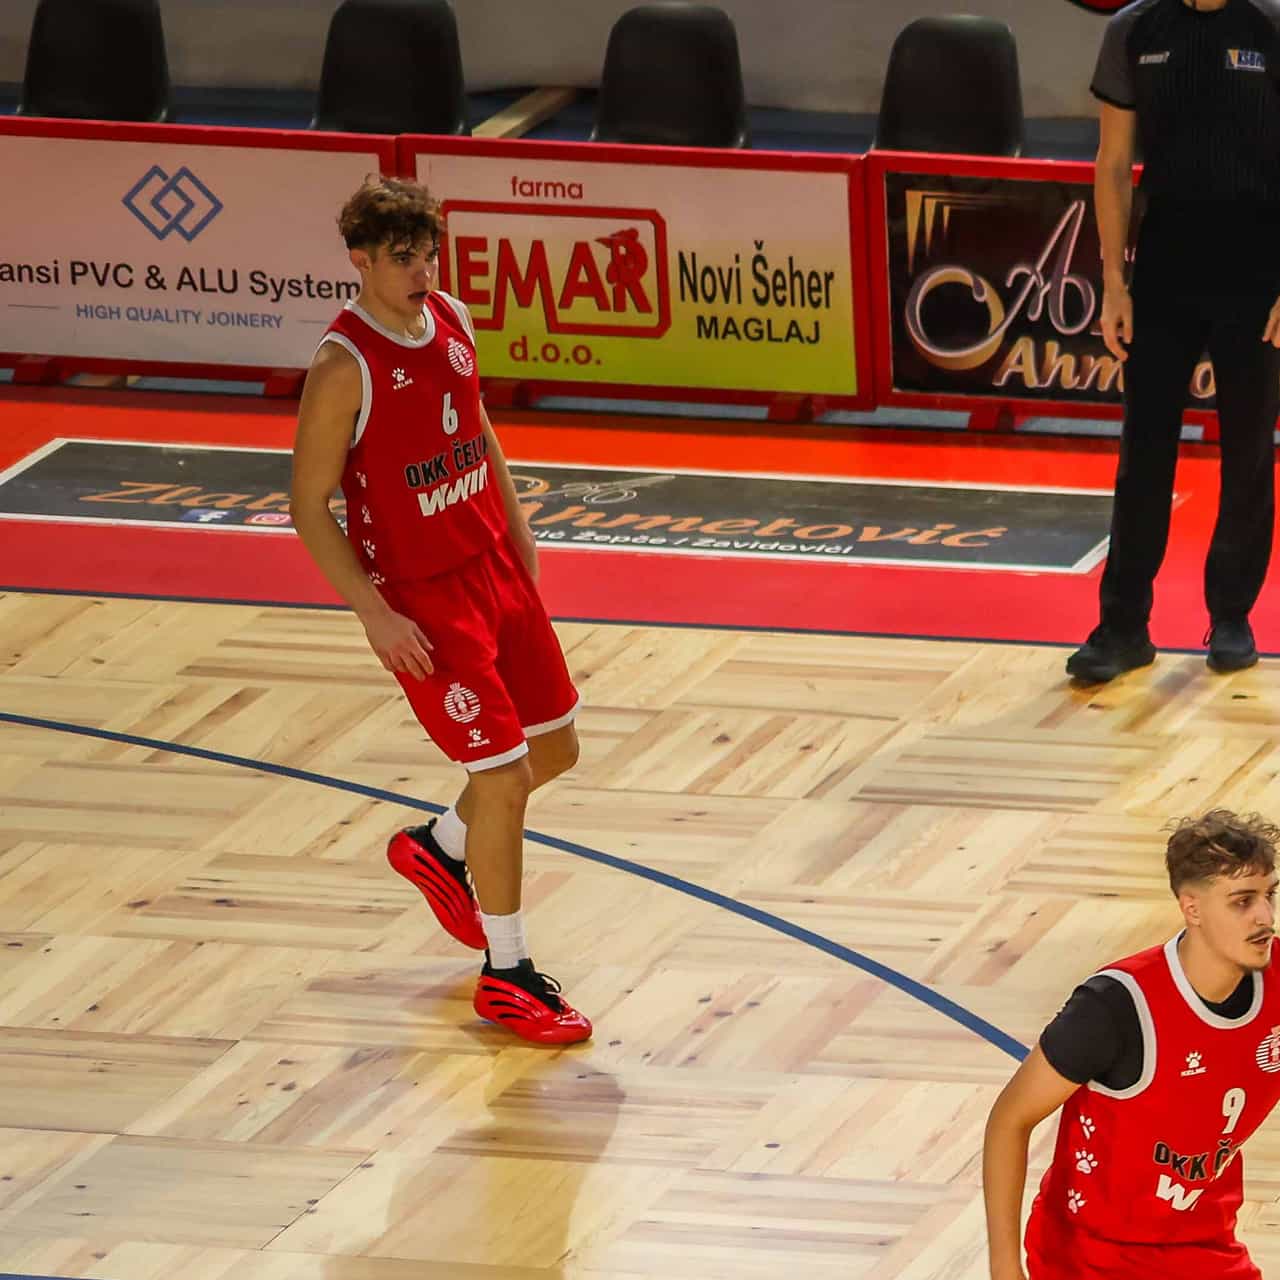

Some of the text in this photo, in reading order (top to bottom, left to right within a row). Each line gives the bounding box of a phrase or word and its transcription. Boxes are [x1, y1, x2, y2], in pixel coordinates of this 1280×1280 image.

[511, 176, 584, 200] farma
[70, 261, 134, 289] PVC
[145, 265, 168, 291] &
[176, 266, 240, 295] ALU
[455, 228, 654, 314] EMAR
[678, 240, 835, 310] Novi Šeher
[76, 304, 283, 329] HIGH QUALITY JOINERY
[696, 315, 821, 345] MAGLAJ
[509, 336, 602, 366] d.o.o.
[441, 391, 459, 436] 6
[404, 433, 488, 489] OKK ČELI
[1221, 1087, 1247, 1135] 9
[1153, 1140, 1209, 1181] OKK
